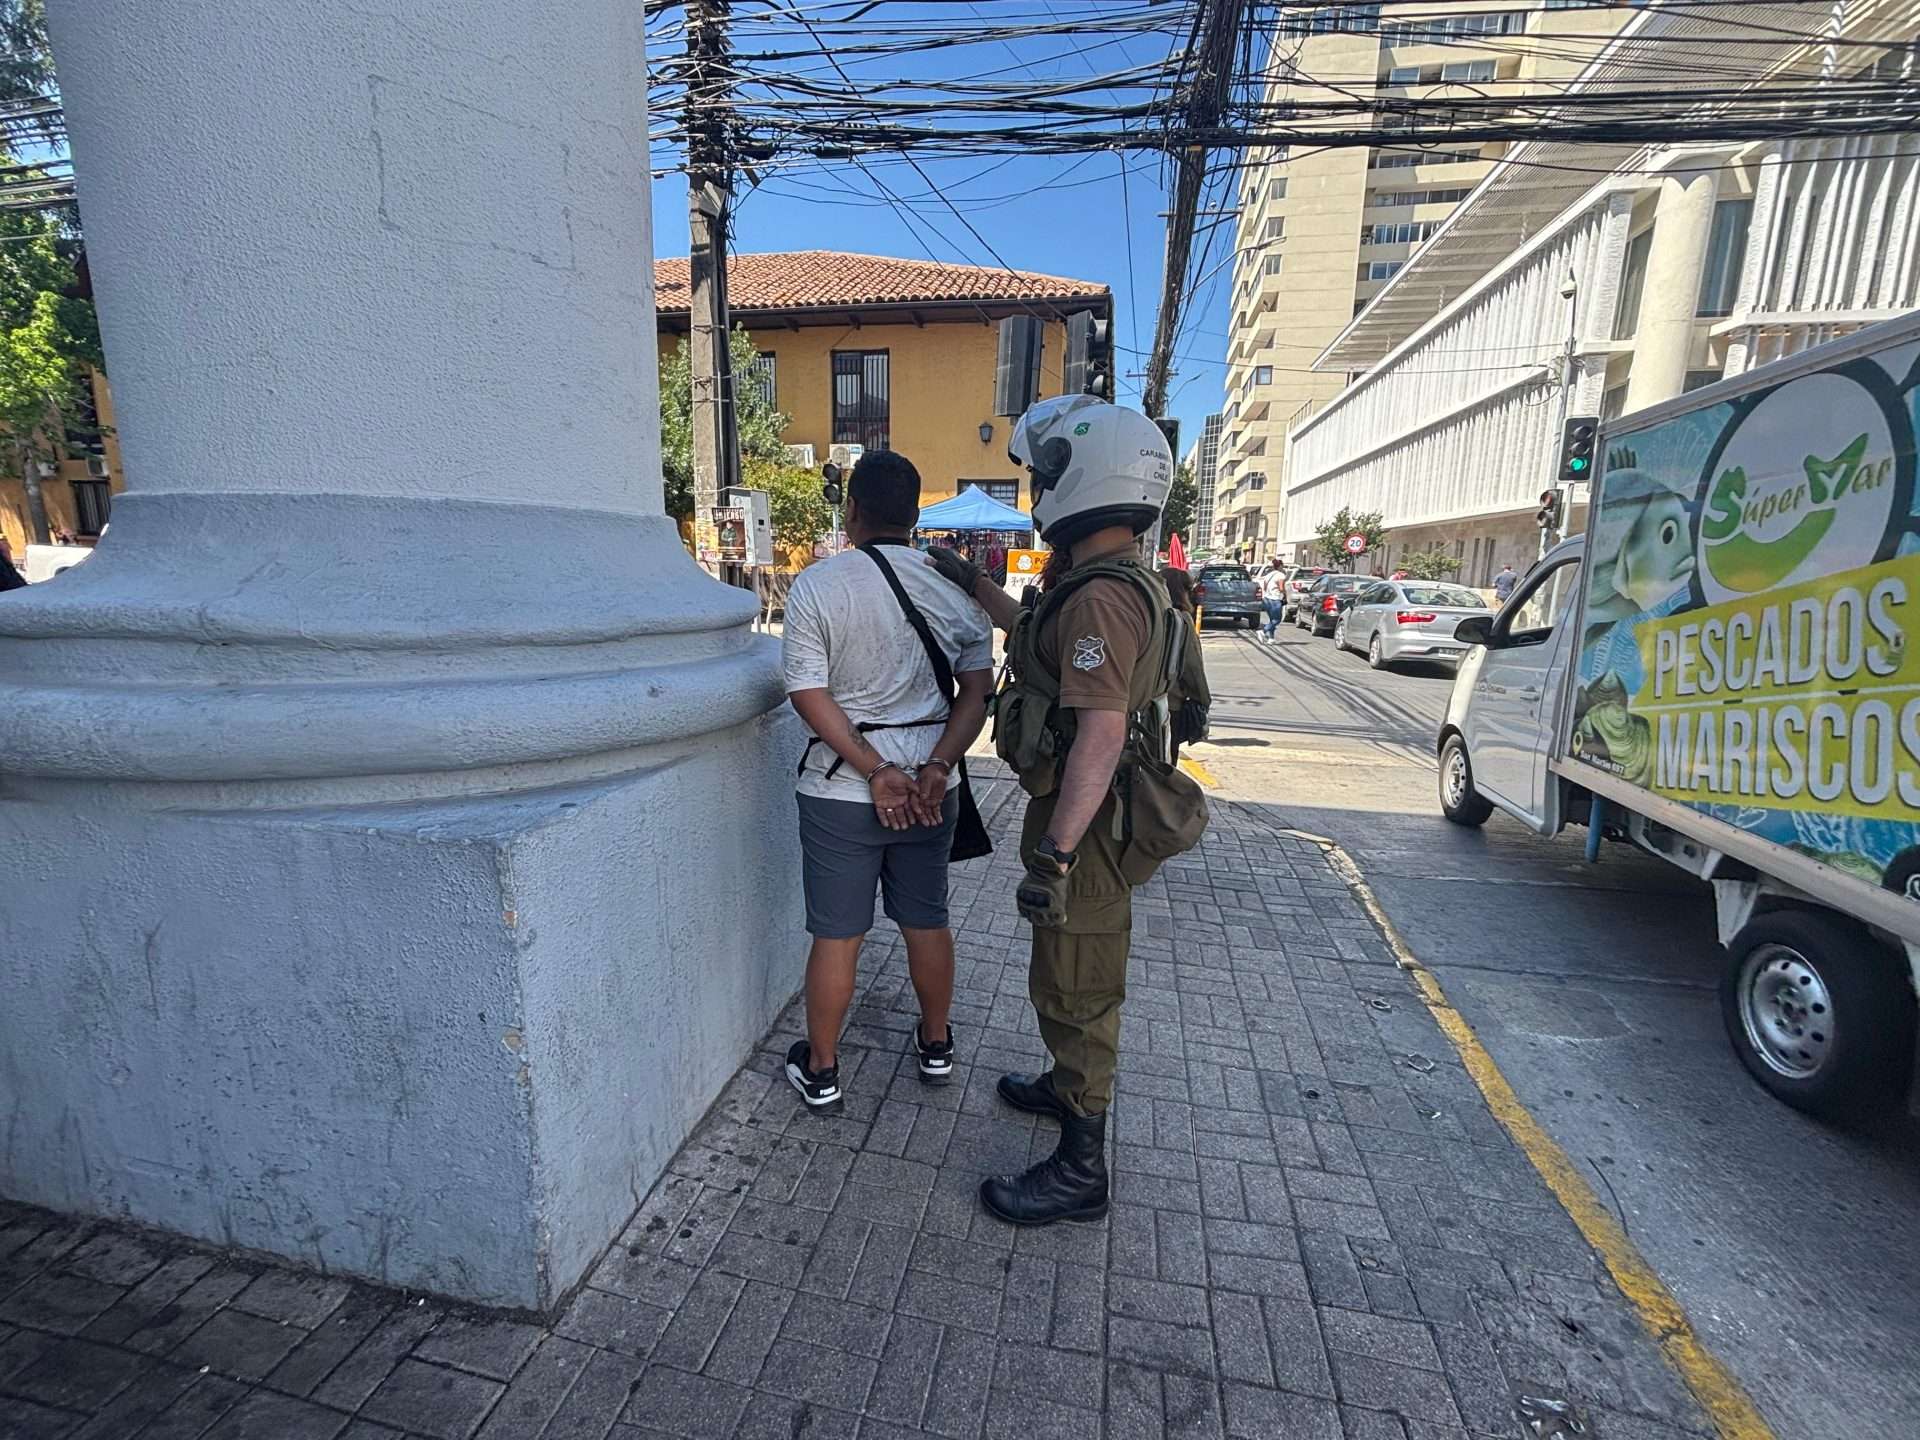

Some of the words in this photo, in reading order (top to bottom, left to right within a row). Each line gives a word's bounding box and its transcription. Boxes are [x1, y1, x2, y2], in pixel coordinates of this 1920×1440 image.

[1350, 539, 1361, 548] 20
[1655, 576, 1908, 698] PESCADOS
[1656, 696, 1920, 809] MARISCOS
